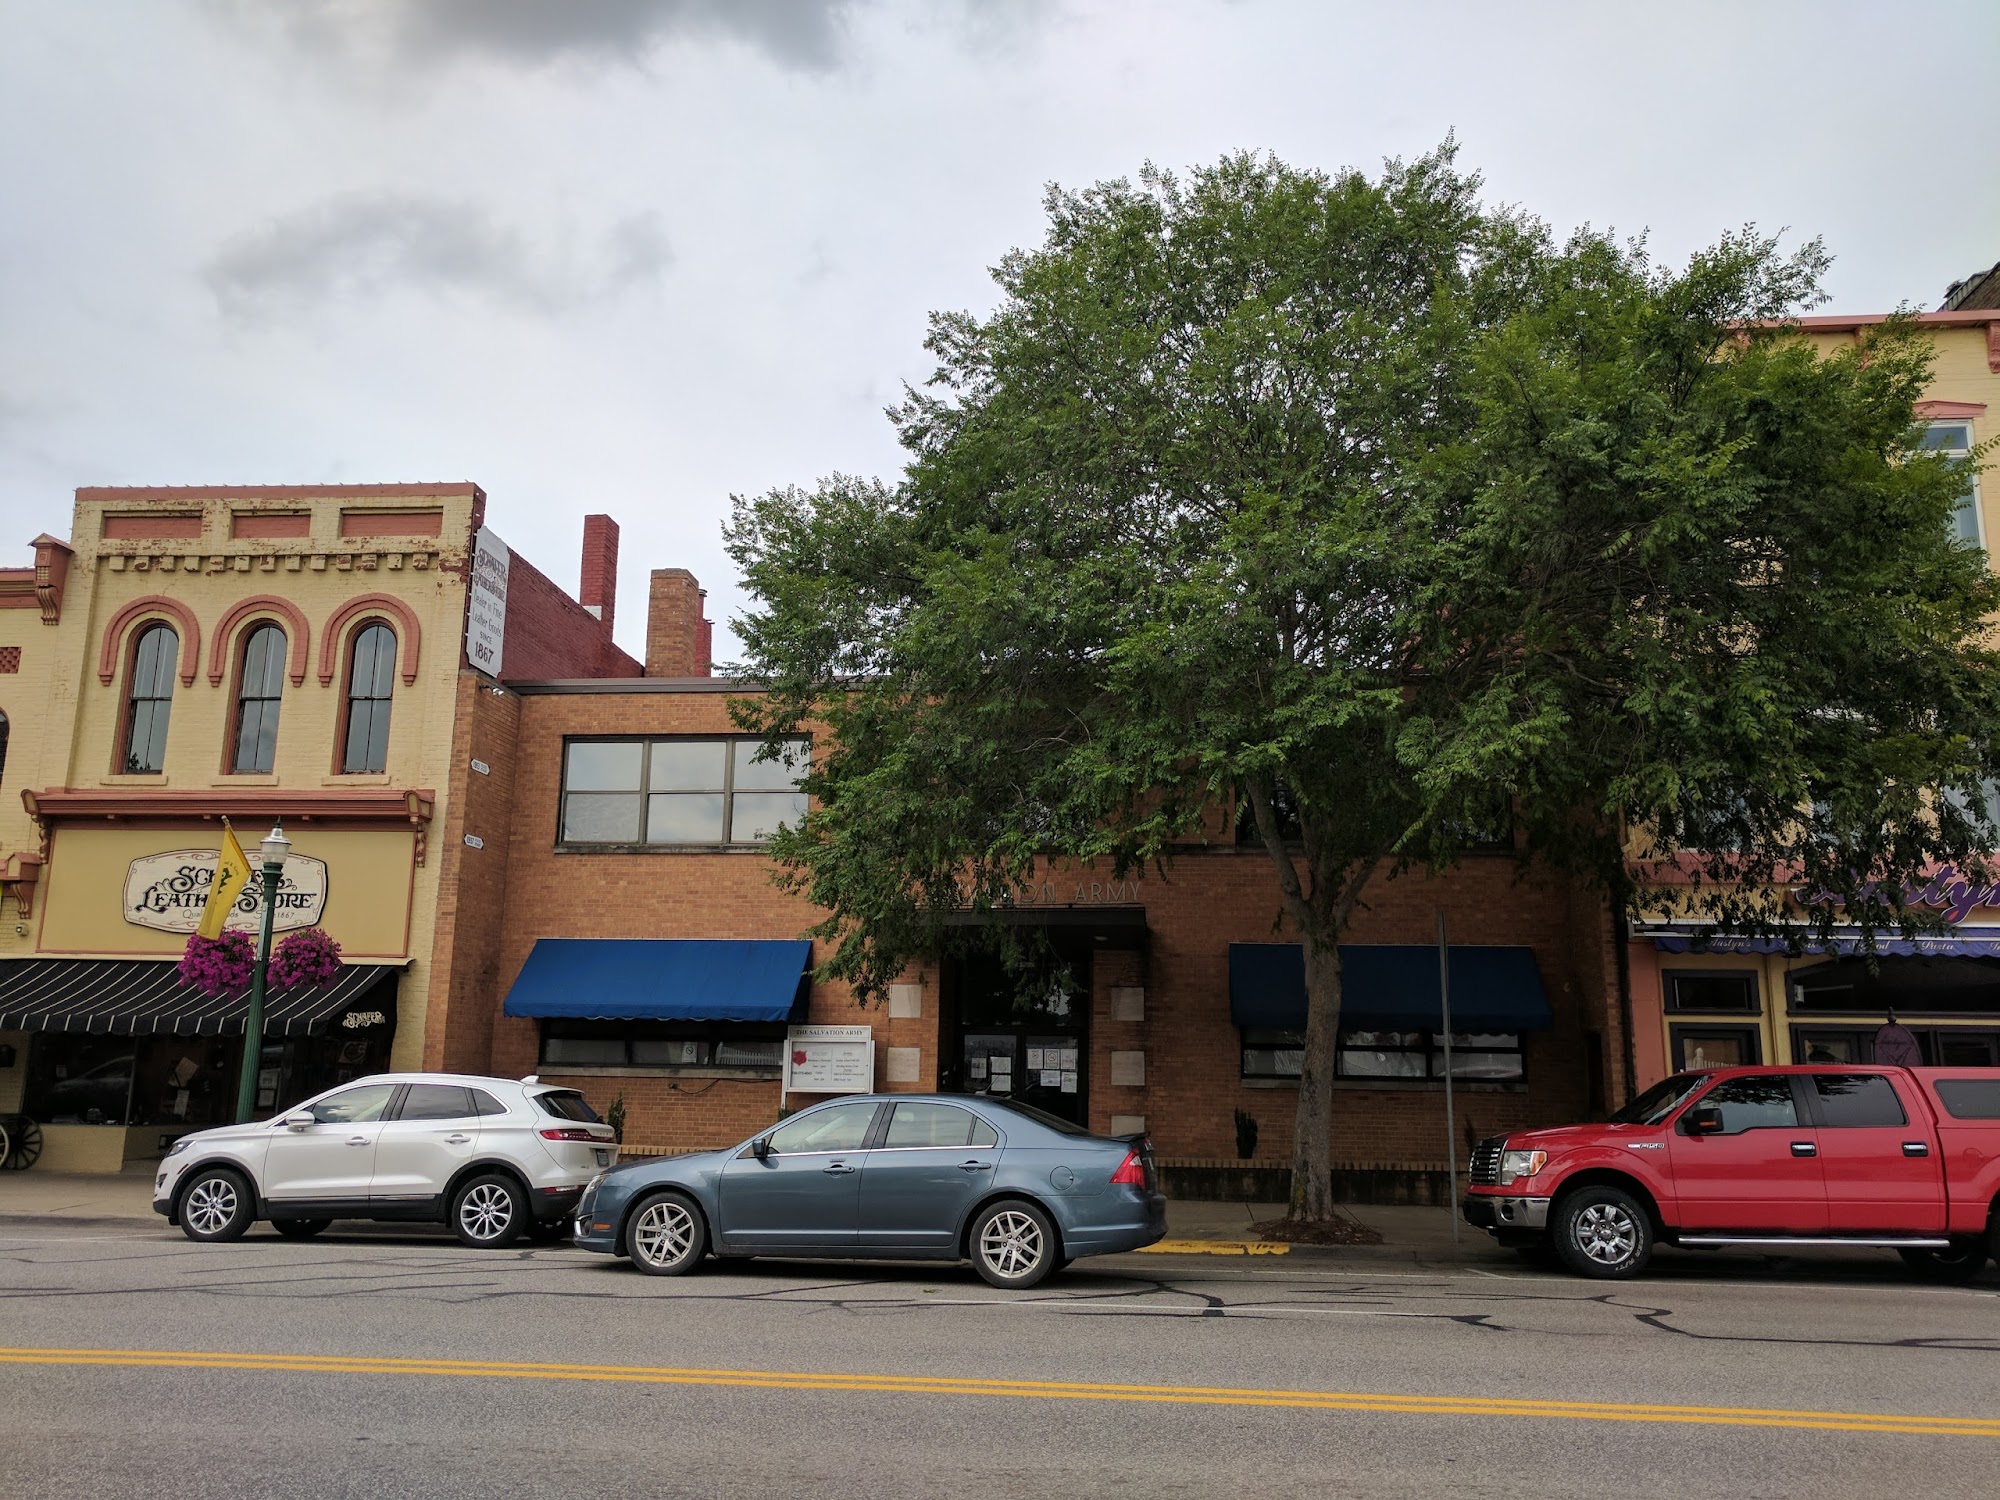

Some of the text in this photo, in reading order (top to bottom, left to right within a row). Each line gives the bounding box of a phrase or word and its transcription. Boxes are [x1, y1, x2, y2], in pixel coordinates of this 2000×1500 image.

[473, 589, 487, 609] Dealer
[493, 602, 502, 620] Fine
[472, 606, 502, 638] Leather Goods
[479, 631, 493, 645] SINCE
[475, 641, 494, 665] 1867
[237, 887, 317, 913] SORE
[1075, 881, 1141, 902] ARMY
[277, 911, 295, 919] 1867
[1921, 941, 1954, 951] Pasta
